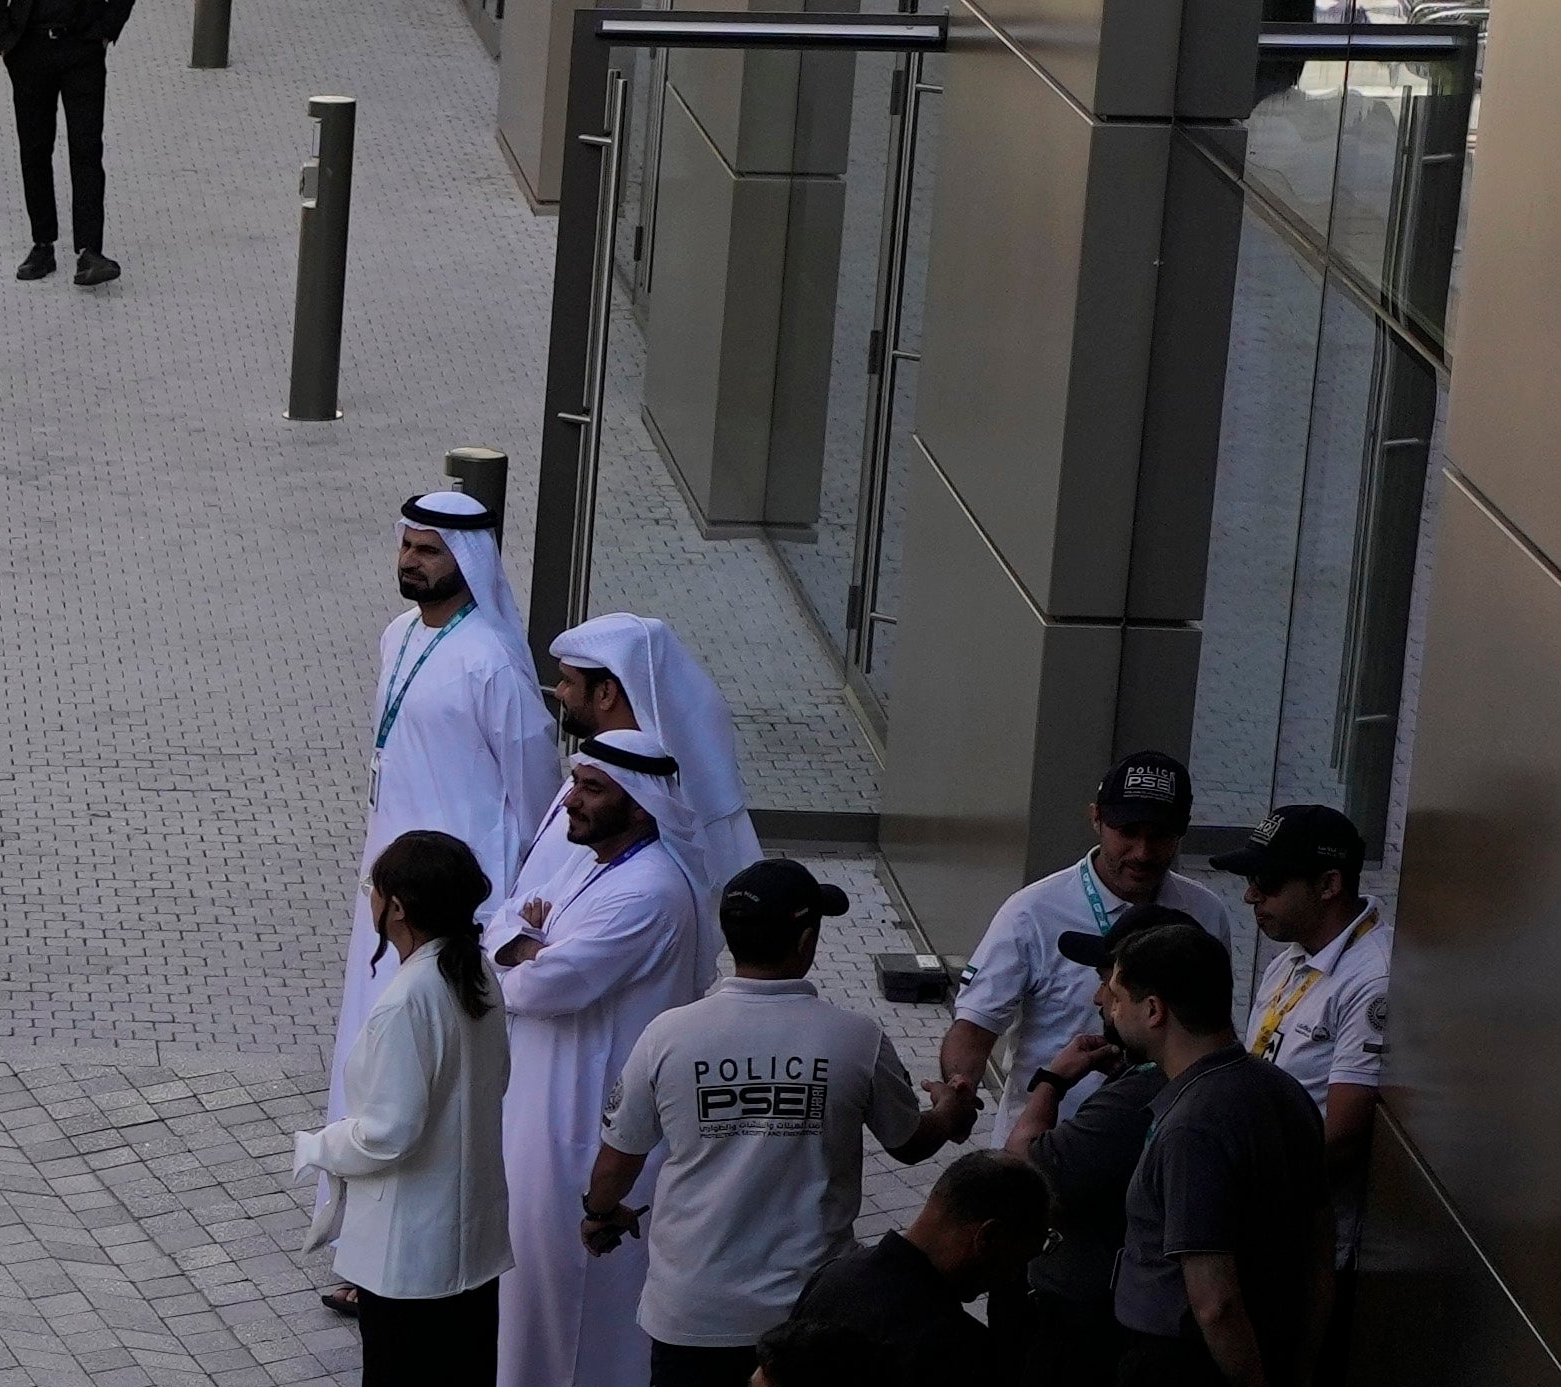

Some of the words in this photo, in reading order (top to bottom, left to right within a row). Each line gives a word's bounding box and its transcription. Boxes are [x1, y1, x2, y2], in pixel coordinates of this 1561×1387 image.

[1128, 776, 1170, 791] PSE
[694, 1056, 829, 1084] POLICE
[700, 1086, 806, 1119] PSE
